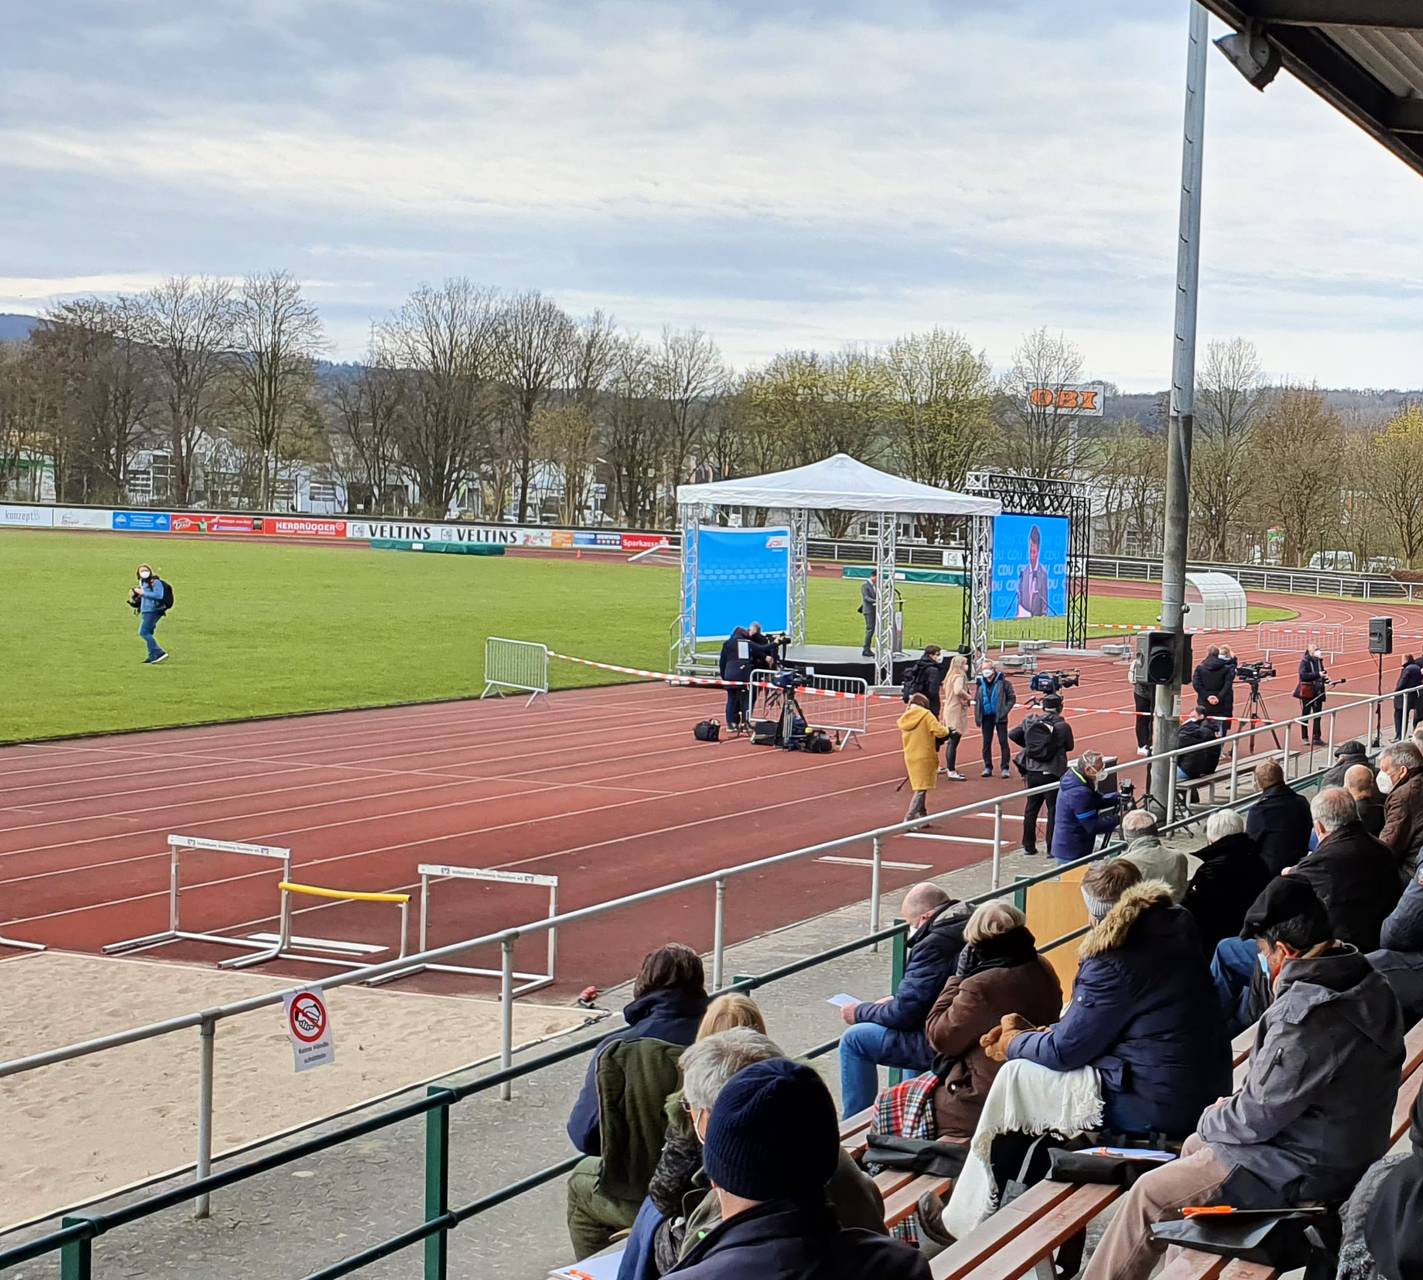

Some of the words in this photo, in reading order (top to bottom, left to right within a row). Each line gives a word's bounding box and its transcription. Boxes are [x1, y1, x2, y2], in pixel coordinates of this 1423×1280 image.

[1030, 388, 1097, 409] OBI
[276, 521, 335, 531] HERBRÜGGER
[368, 524, 431, 540] VELTINS
[457, 528, 517, 543] VELTINS
[623, 538, 659, 548] Sparkasse
